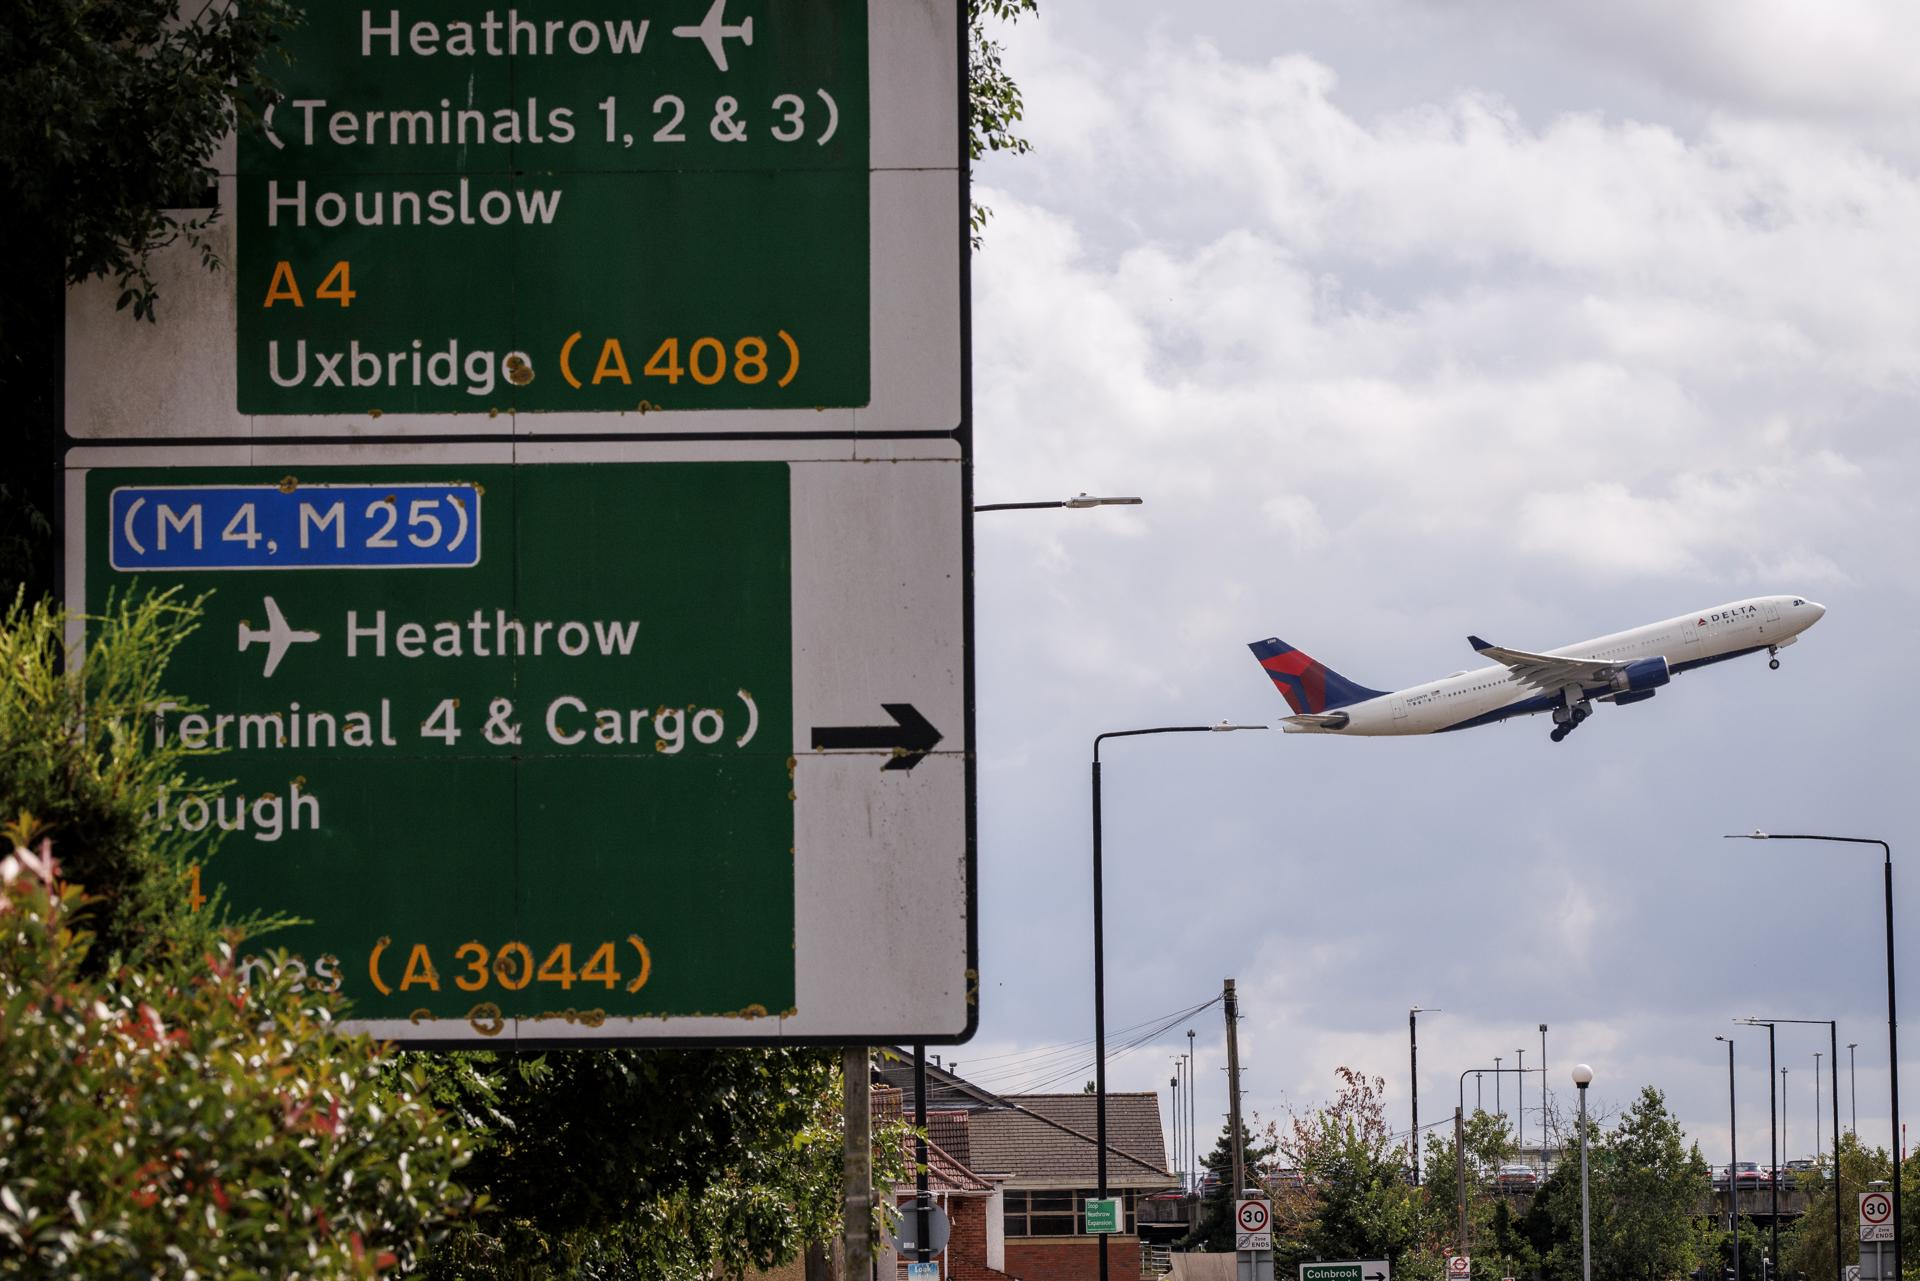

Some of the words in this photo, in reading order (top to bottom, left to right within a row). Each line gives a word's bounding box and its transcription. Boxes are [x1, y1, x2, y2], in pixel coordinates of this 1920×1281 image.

[362, 9, 650, 56] Heathrow
[264, 92, 576, 150] (Terminals
[598, 96, 634, 148] 1,
[652, 94, 686, 142] 2
[709, 95, 748, 142] &
[770, 88, 839, 146] 3)
[267, 178, 562, 227] Hounslow
[268, 339, 534, 396] Uxbridge
[347, 609, 640, 658] Heathrow
[1711, 605, 1757, 622] DELTA
[420, 698, 461, 746] 4
[484, 697, 522, 746] &
[545, 689, 759, 754] Cargo)
[137, 776, 320, 842] lough
[1243, 1210, 1264, 1223] 30
[1866, 1202, 1887, 1215] 30
[1306, 1268, 1358, 1279] Colnbrook
